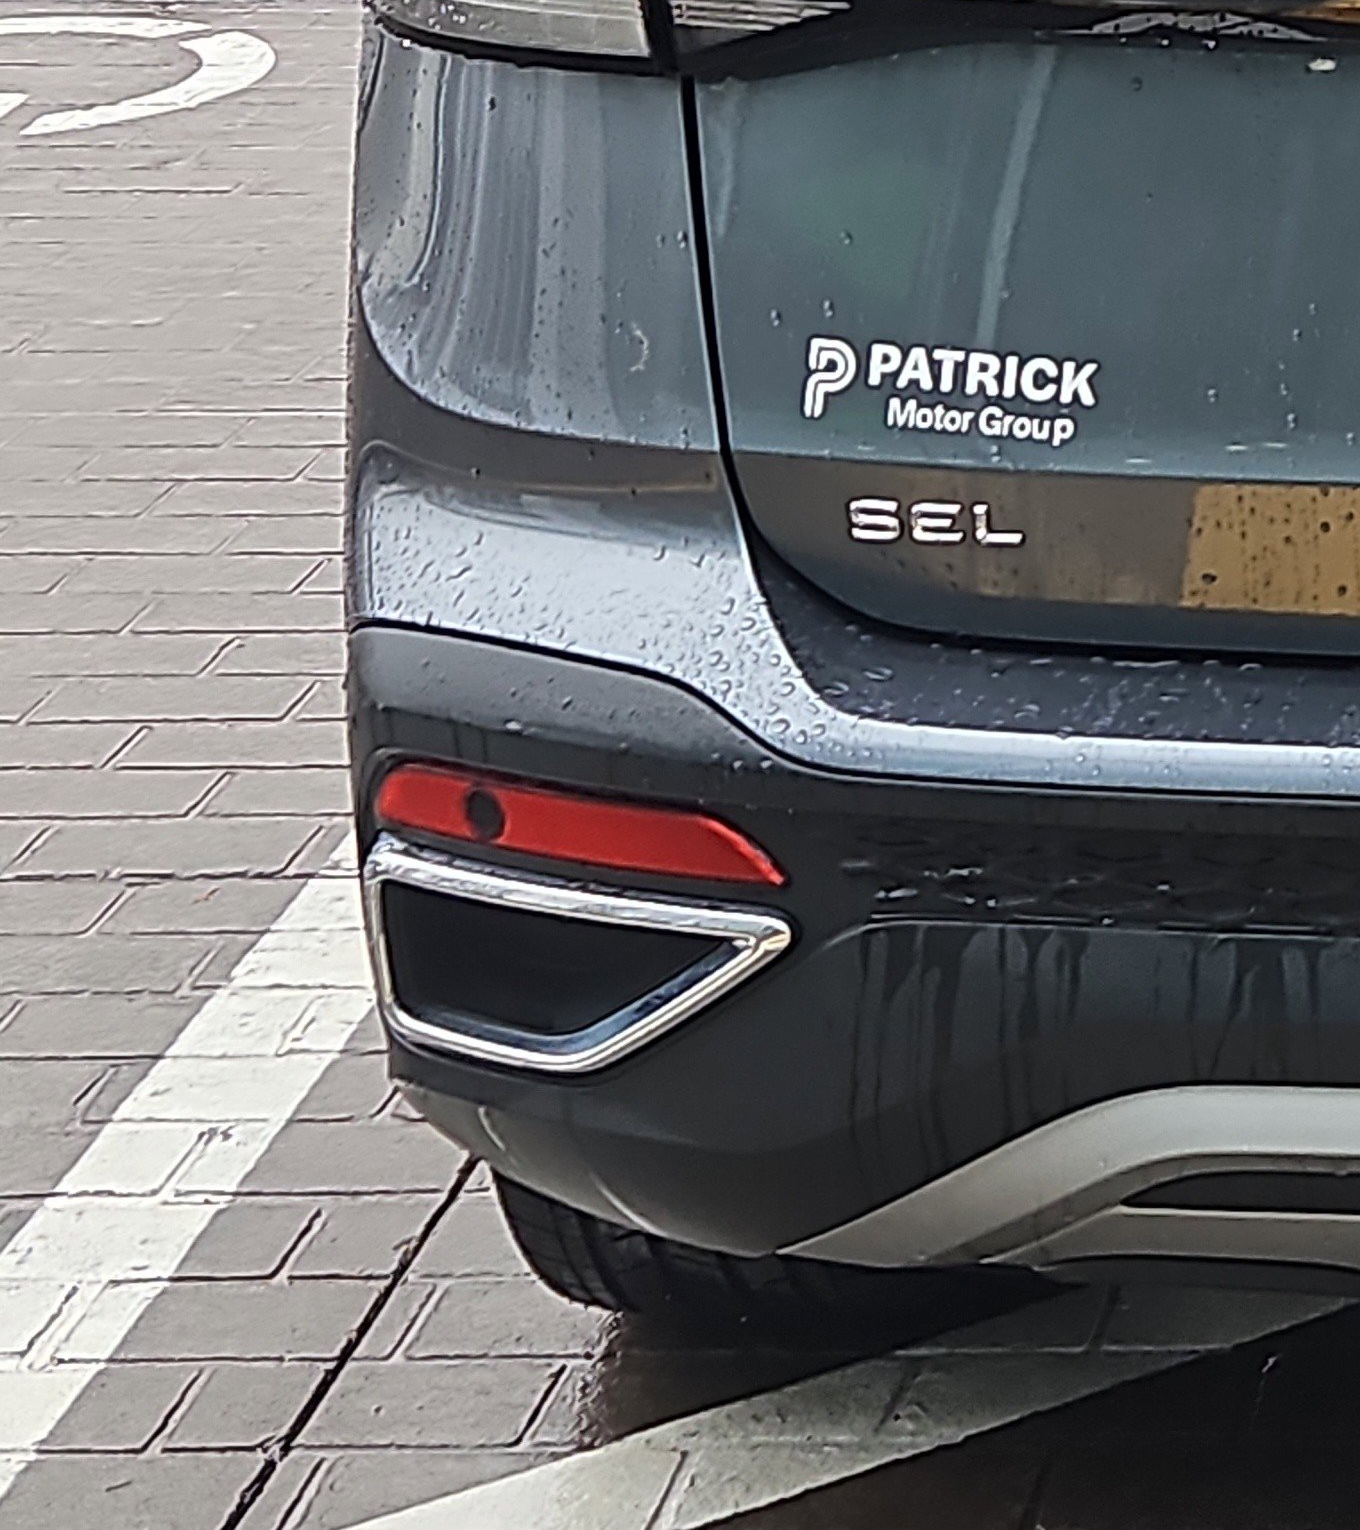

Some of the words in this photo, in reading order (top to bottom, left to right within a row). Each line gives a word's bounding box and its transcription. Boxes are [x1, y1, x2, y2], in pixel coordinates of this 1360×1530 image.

[867, 342, 1098, 407] PATRICK
[887, 397, 975, 434] Motor
[978, 406, 1076, 447] Group
[848, 498, 1024, 545] SEL
